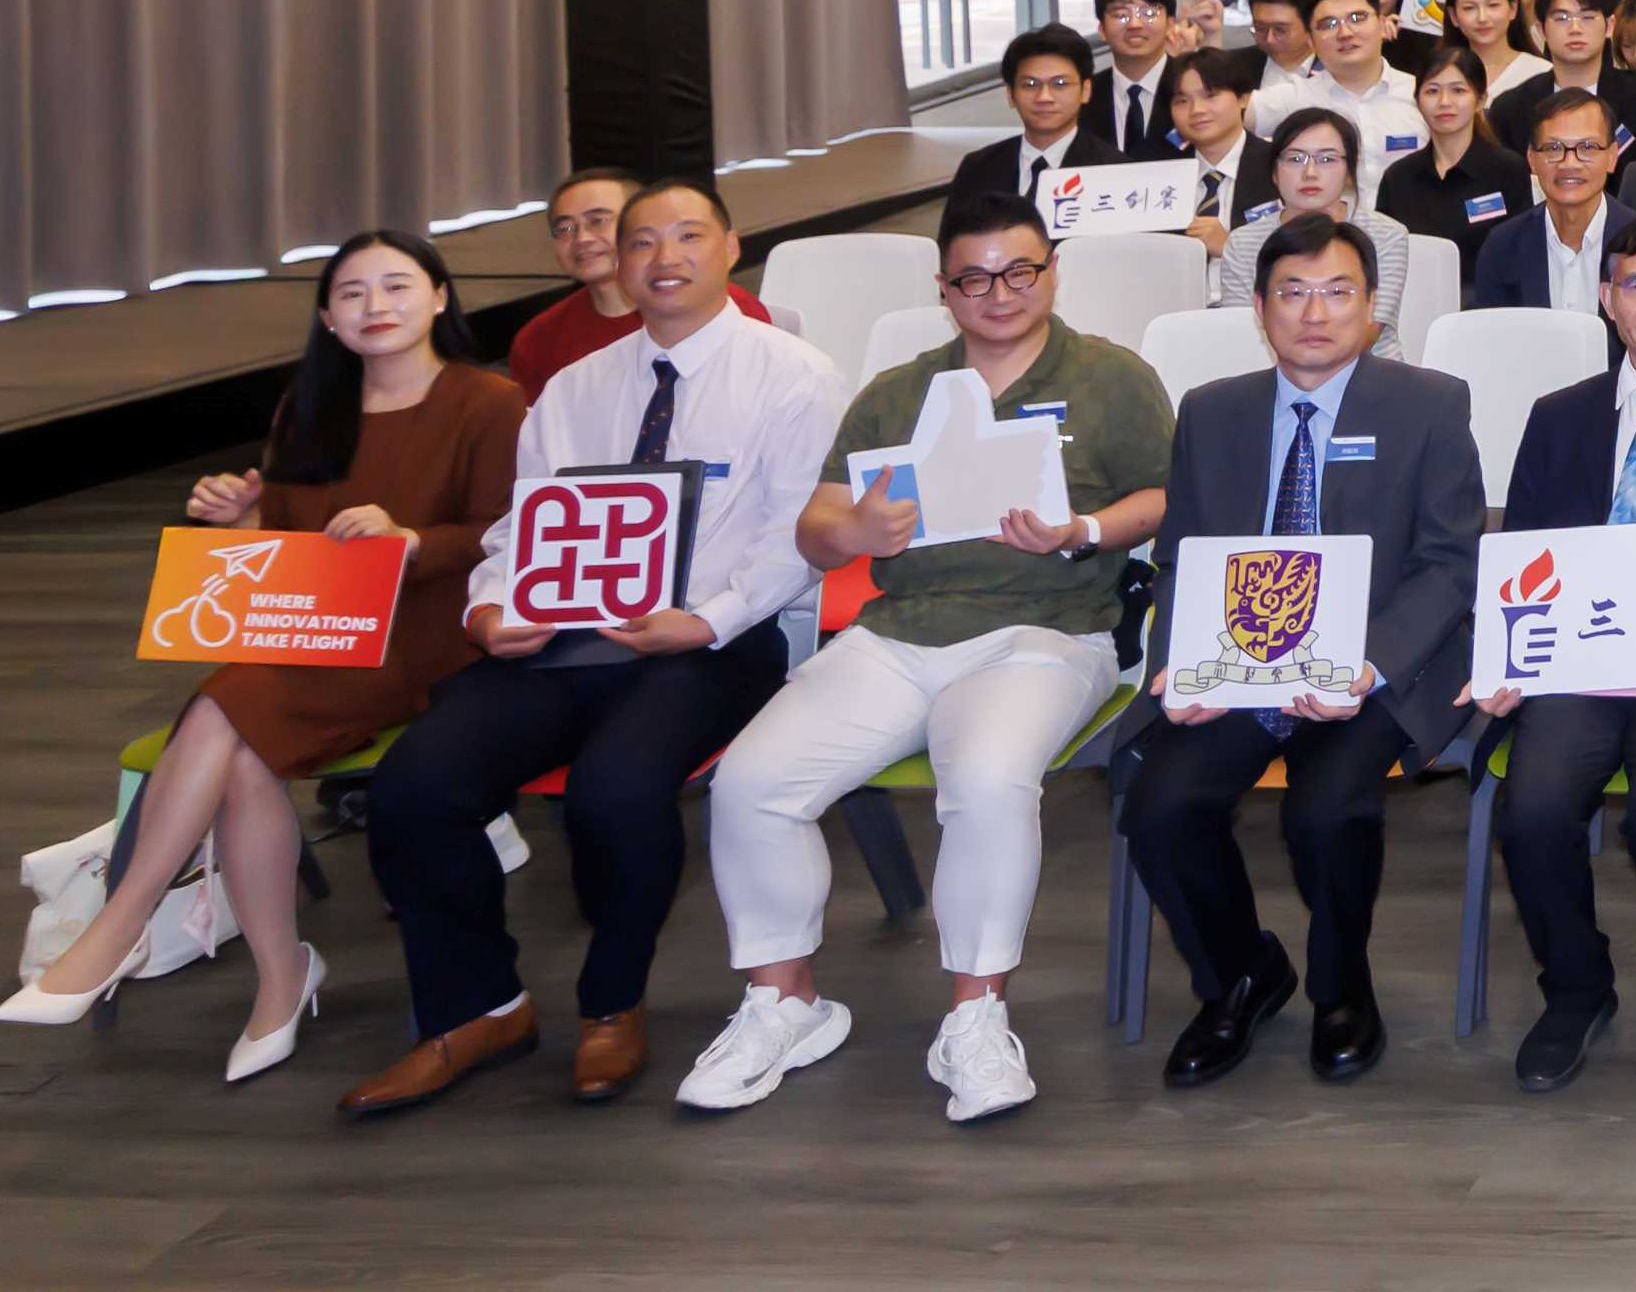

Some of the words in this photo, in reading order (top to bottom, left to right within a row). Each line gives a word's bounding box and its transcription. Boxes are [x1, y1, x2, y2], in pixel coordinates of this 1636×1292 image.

[250, 593, 318, 610] WHERE
[244, 613, 379, 632] INNOVATIONS
[241, 632, 290, 648] TAKE
[291, 634, 359, 651] FLIGHT
